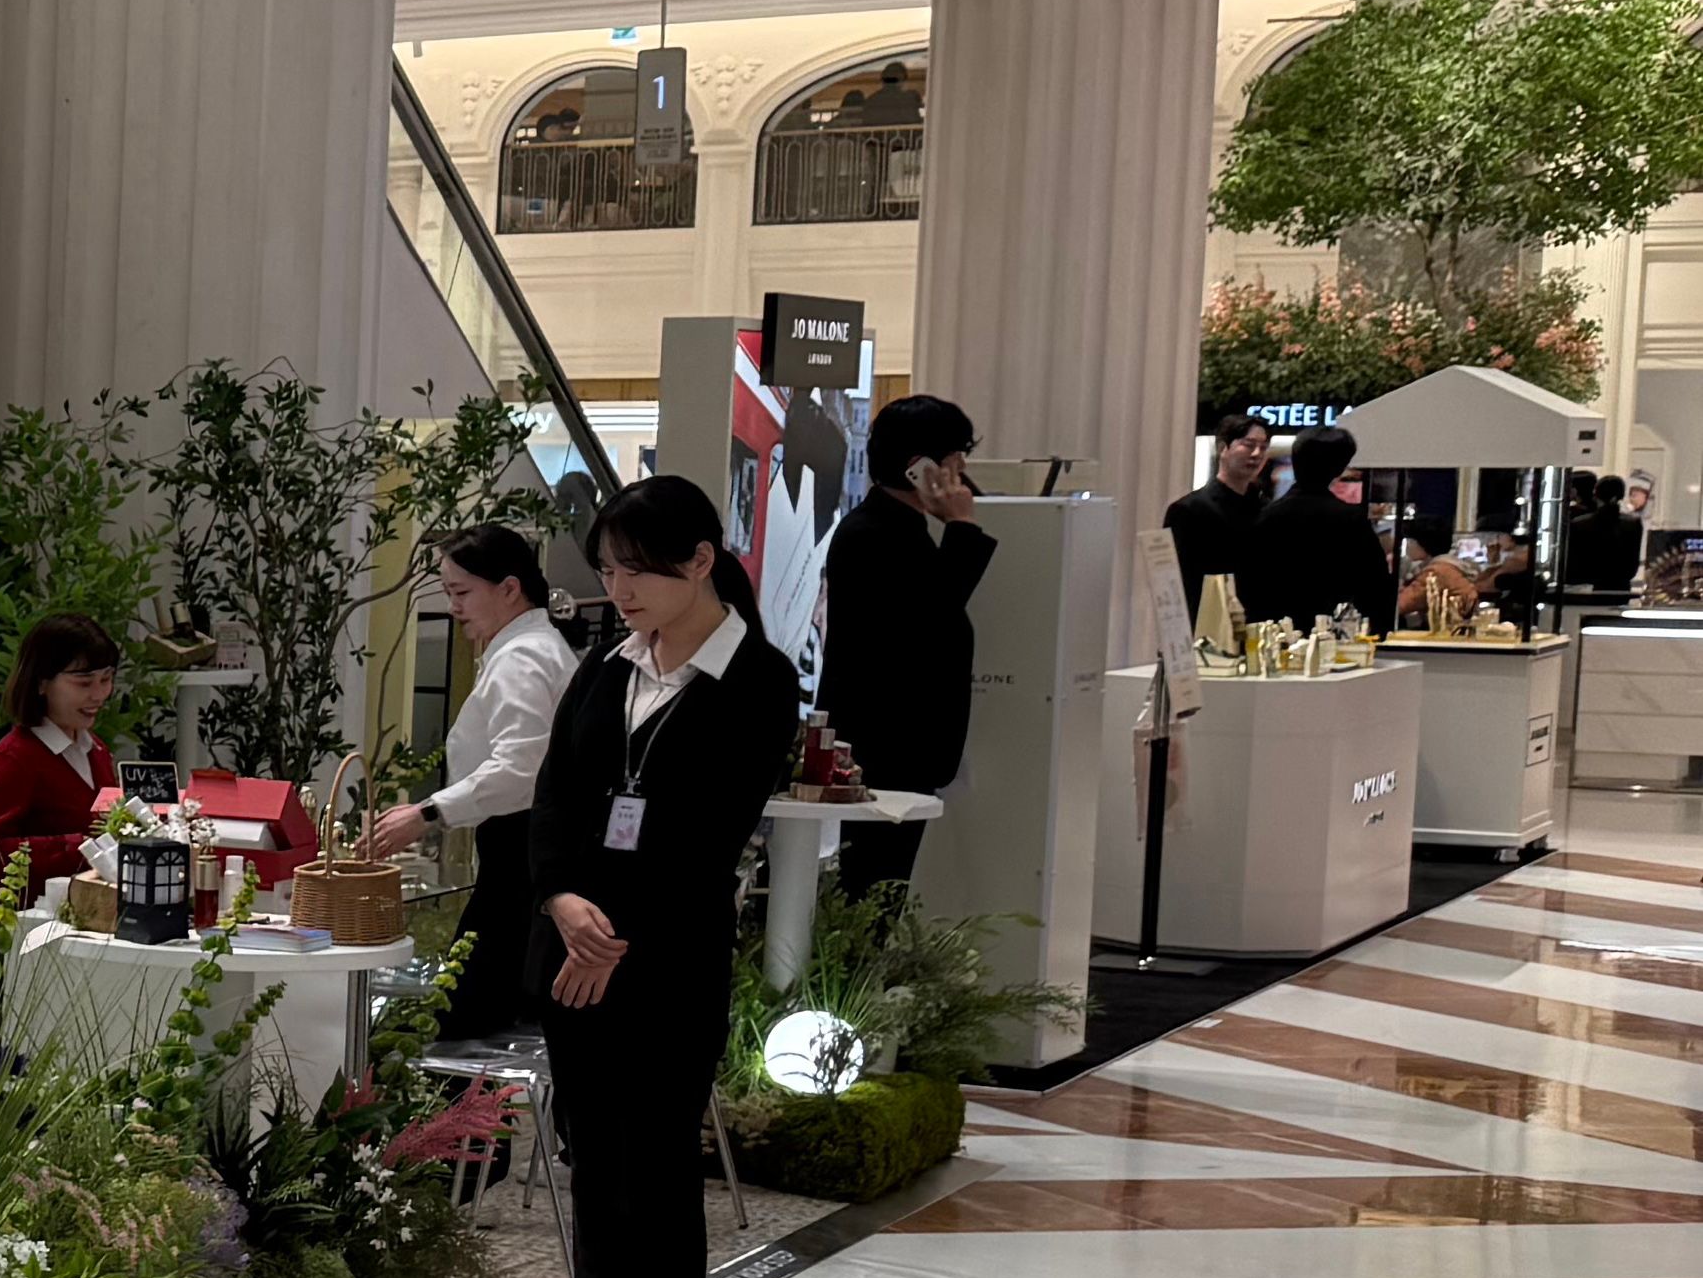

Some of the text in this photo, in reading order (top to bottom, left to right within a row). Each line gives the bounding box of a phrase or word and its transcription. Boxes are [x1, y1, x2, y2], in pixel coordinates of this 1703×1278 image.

[652, 75, 665, 110] 1
[791, 317, 850, 343] JO MALONE
[125, 767, 147, 782] UV
